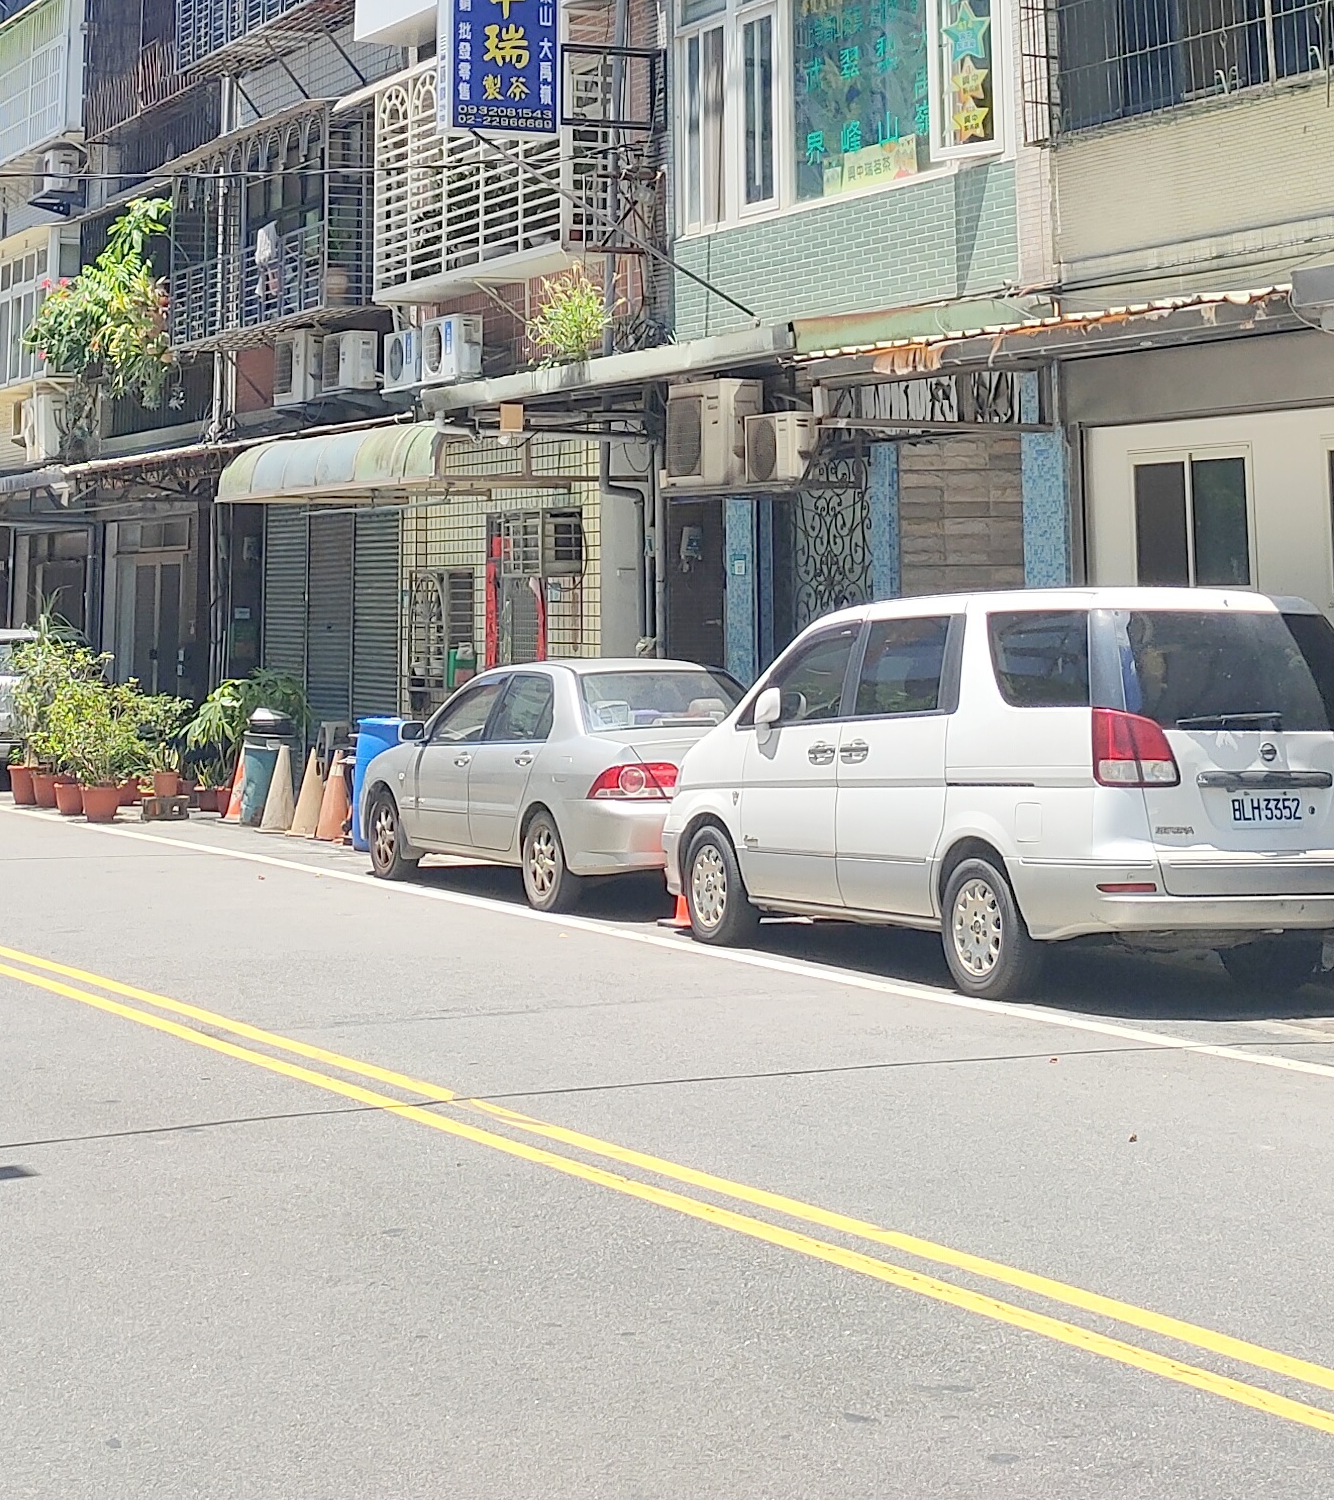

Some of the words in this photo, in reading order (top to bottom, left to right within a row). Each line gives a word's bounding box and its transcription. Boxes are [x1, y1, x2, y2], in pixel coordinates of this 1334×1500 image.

[458, 22, 472, 101] 批發零售
[538, 37, 553, 106] 大禹嶺
[482, 73, 531, 101] 製茶
[458, 104, 552, 119] 0932081543
[847, 156, 891, 183] 興中瑞茗茶
